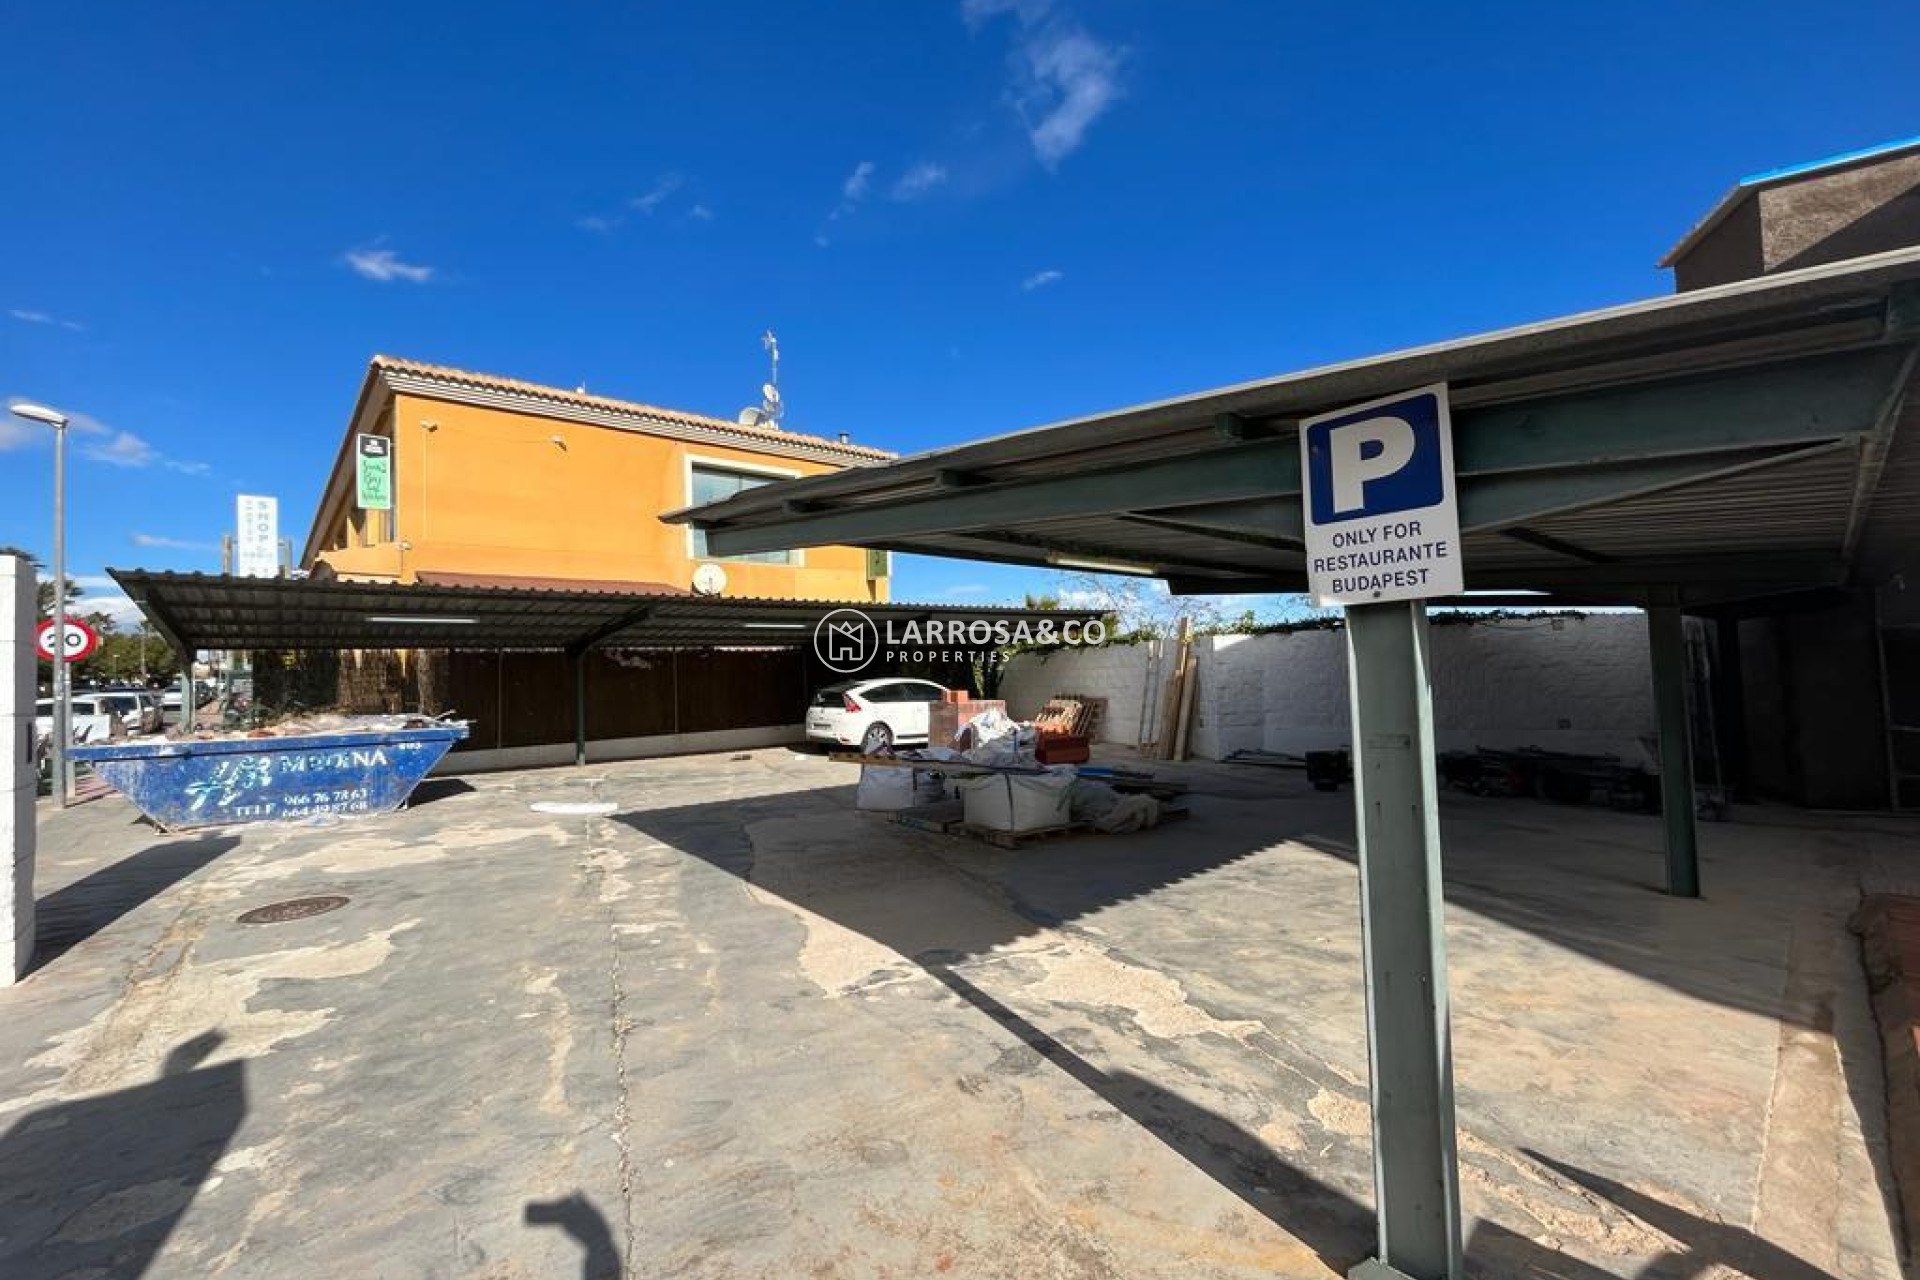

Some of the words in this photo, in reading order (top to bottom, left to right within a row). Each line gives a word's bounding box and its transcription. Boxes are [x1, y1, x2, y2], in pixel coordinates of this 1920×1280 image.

[1330, 416, 1415, 513] P
[1332, 527, 1377, 548] ONLY
[1383, 521, 1422, 541] FOR
[1313, 541, 1447, 573] RESTAURANTE
[1332, 568, 1429, 593] BUDAPEST
